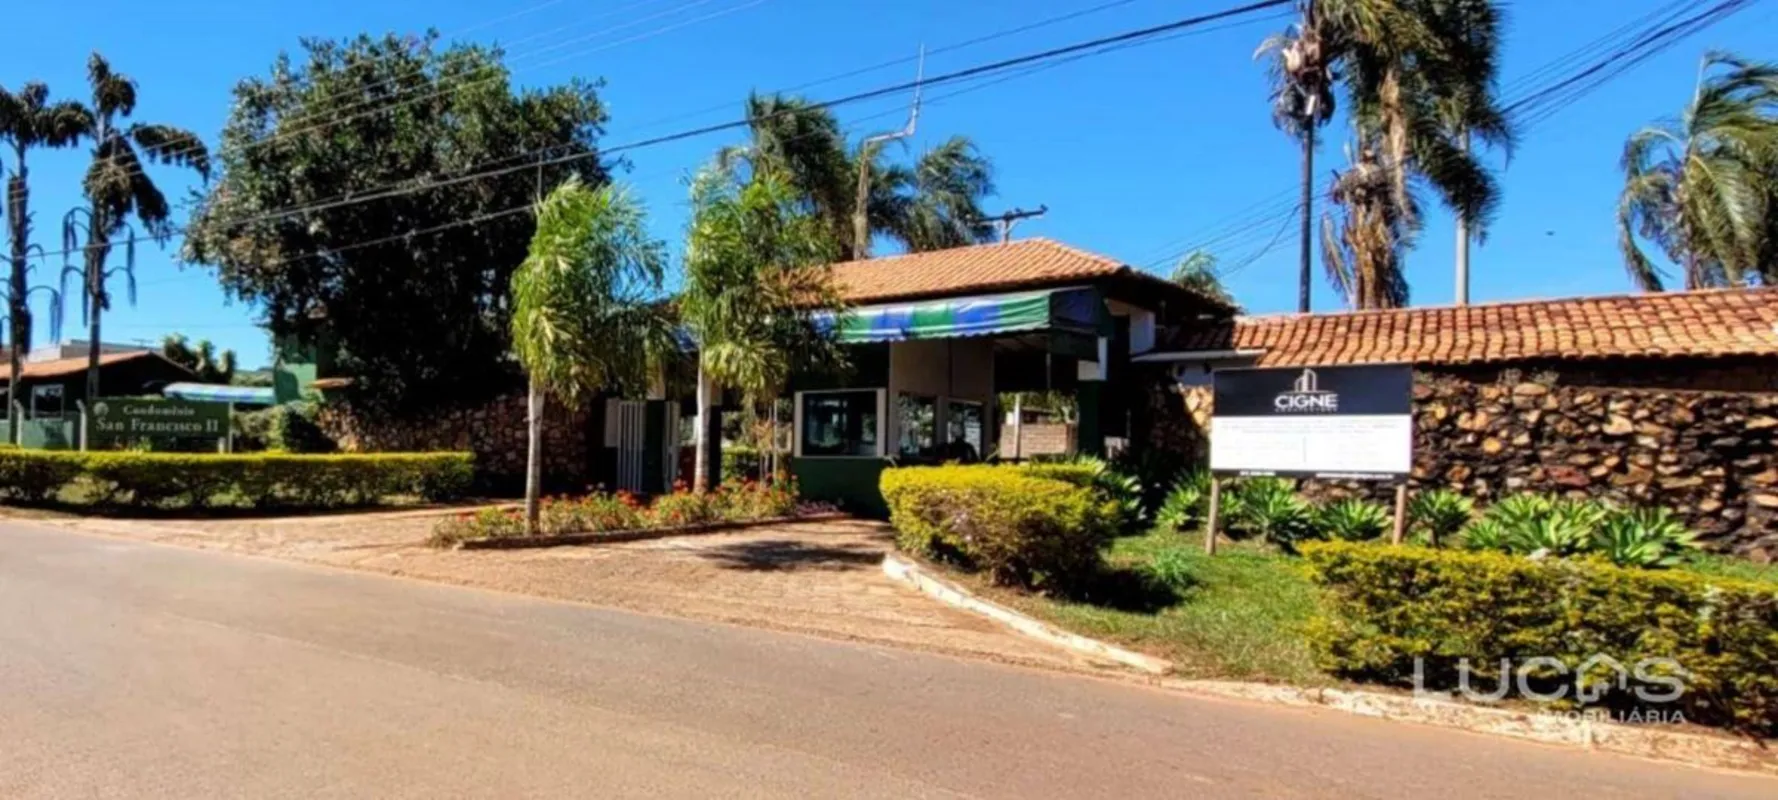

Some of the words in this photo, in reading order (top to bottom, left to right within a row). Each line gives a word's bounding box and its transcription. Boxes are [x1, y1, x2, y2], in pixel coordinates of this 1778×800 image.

[1274, 394, 1339, 409] CIGNE
[96, 417, 124, 432] San
[131, 418, 202, 432] Francisco
[206, 419, 219, 432] II
